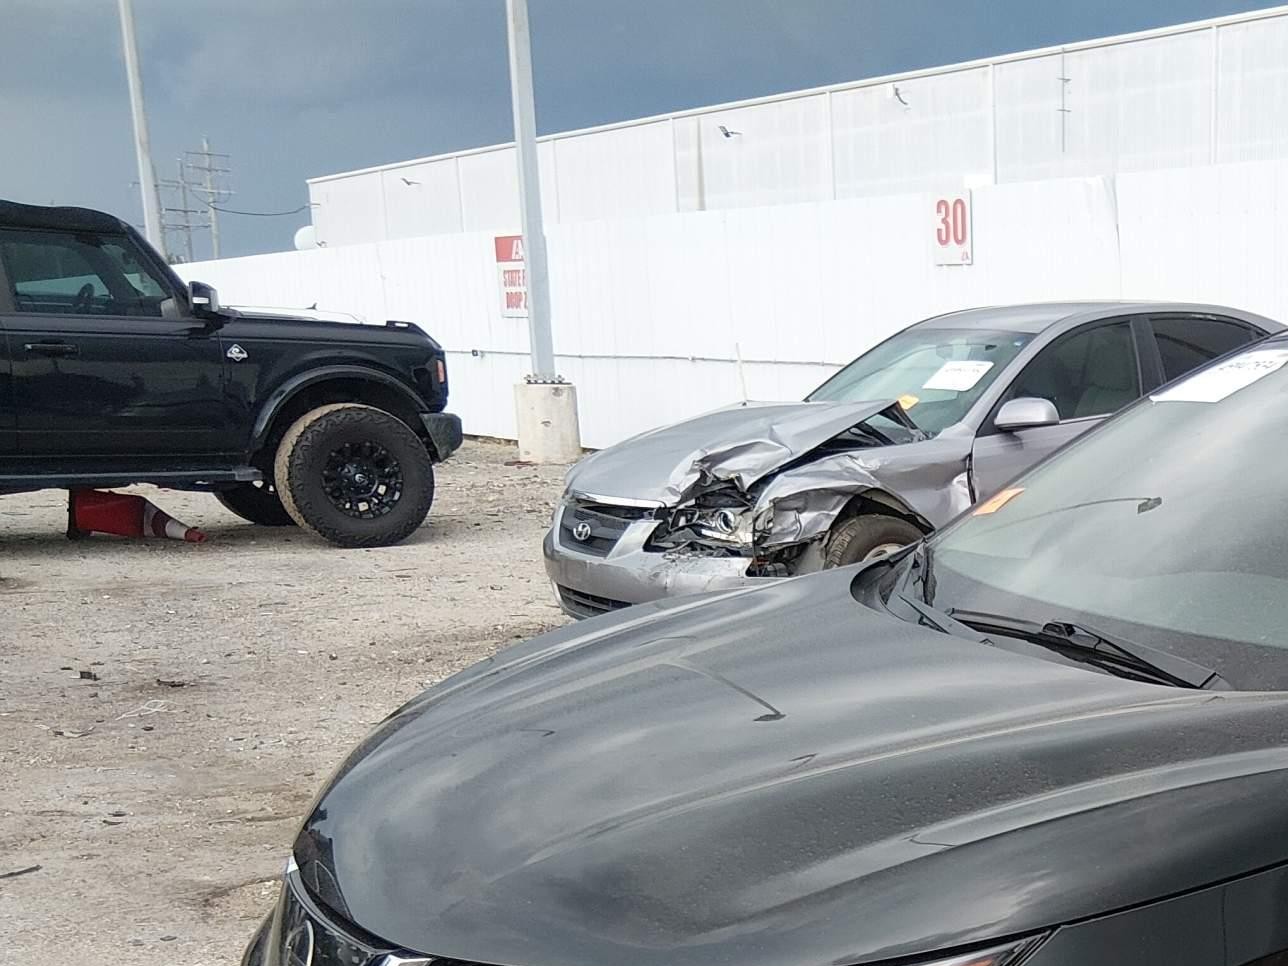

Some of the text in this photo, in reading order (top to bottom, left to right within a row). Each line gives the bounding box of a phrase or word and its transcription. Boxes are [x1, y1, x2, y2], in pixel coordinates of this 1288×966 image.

[936, 198, 967, 246] 30
[503, 269, 522, 287] STATE
[506, 291, 523, 309] DROP
